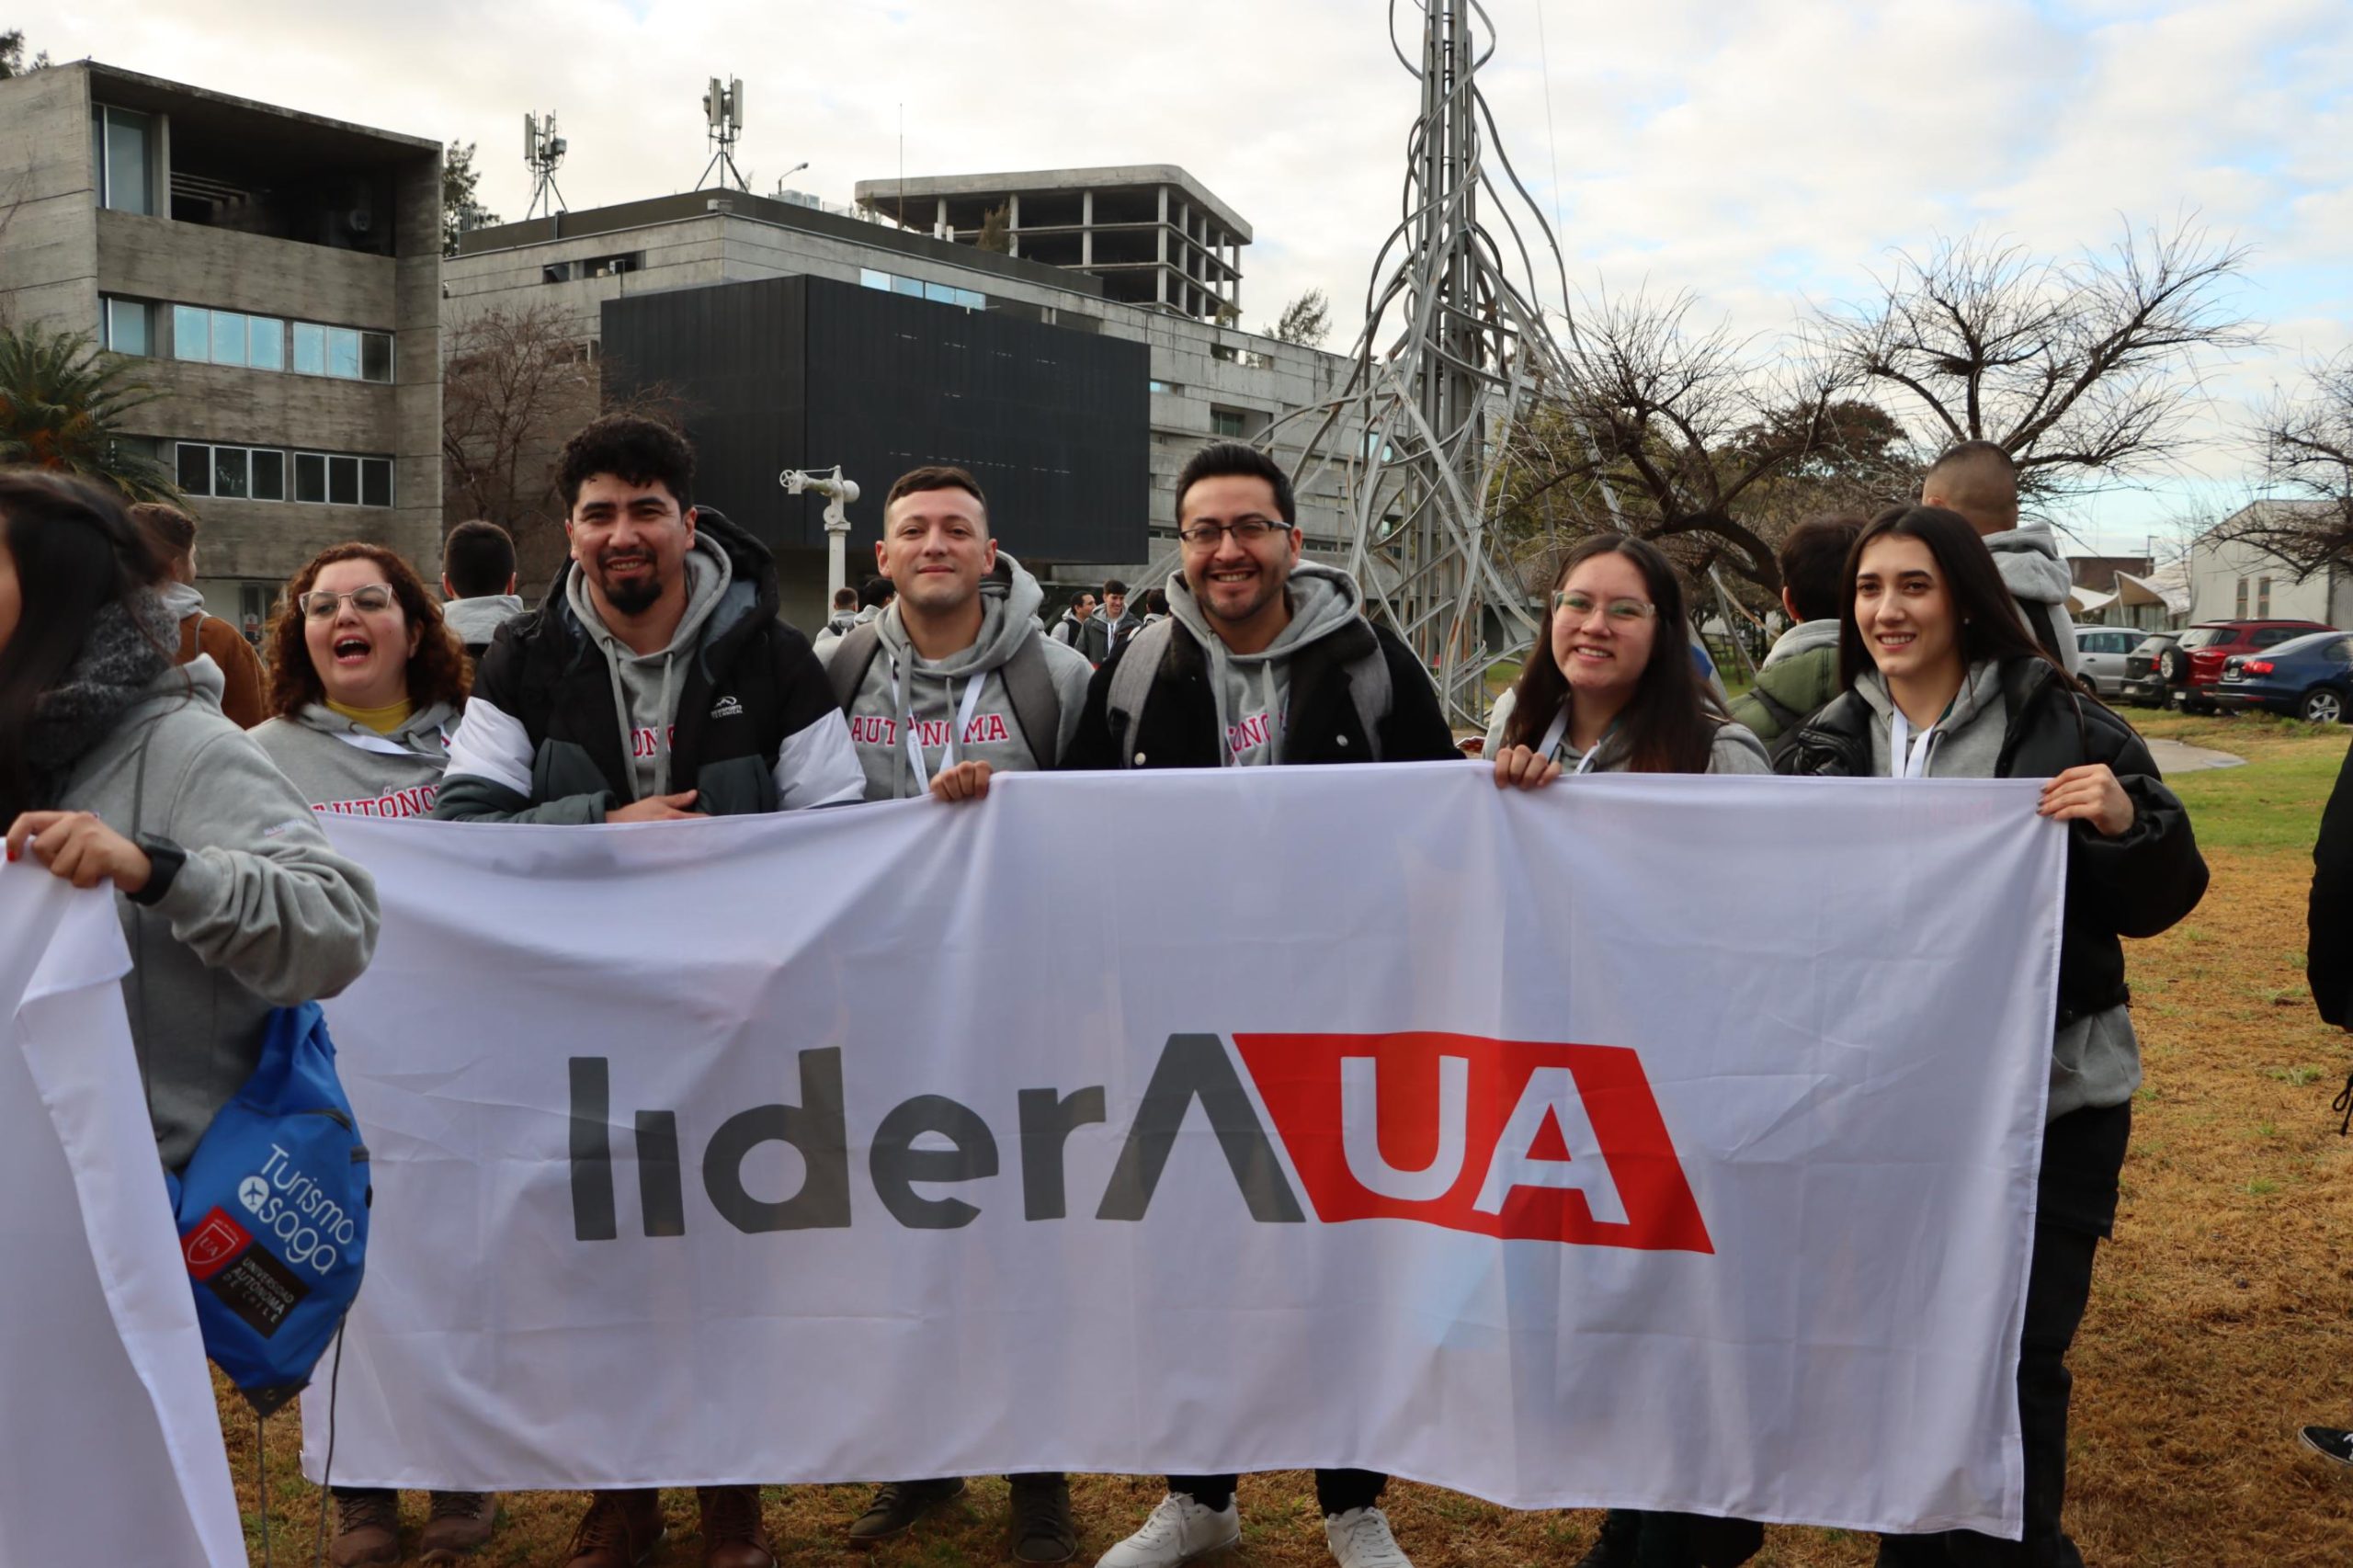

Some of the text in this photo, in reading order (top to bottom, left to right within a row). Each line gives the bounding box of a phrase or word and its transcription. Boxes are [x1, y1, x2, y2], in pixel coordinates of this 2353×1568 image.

[851, 713, 1009, 745] AUTNMA
[261, 1143, 354, 1244] Turismo
[199, 1236, 219, 1257] UA
[258, 1198, 336, 1276] saga
[242, 1257, 295, 1304] UNIVERSIDAD
